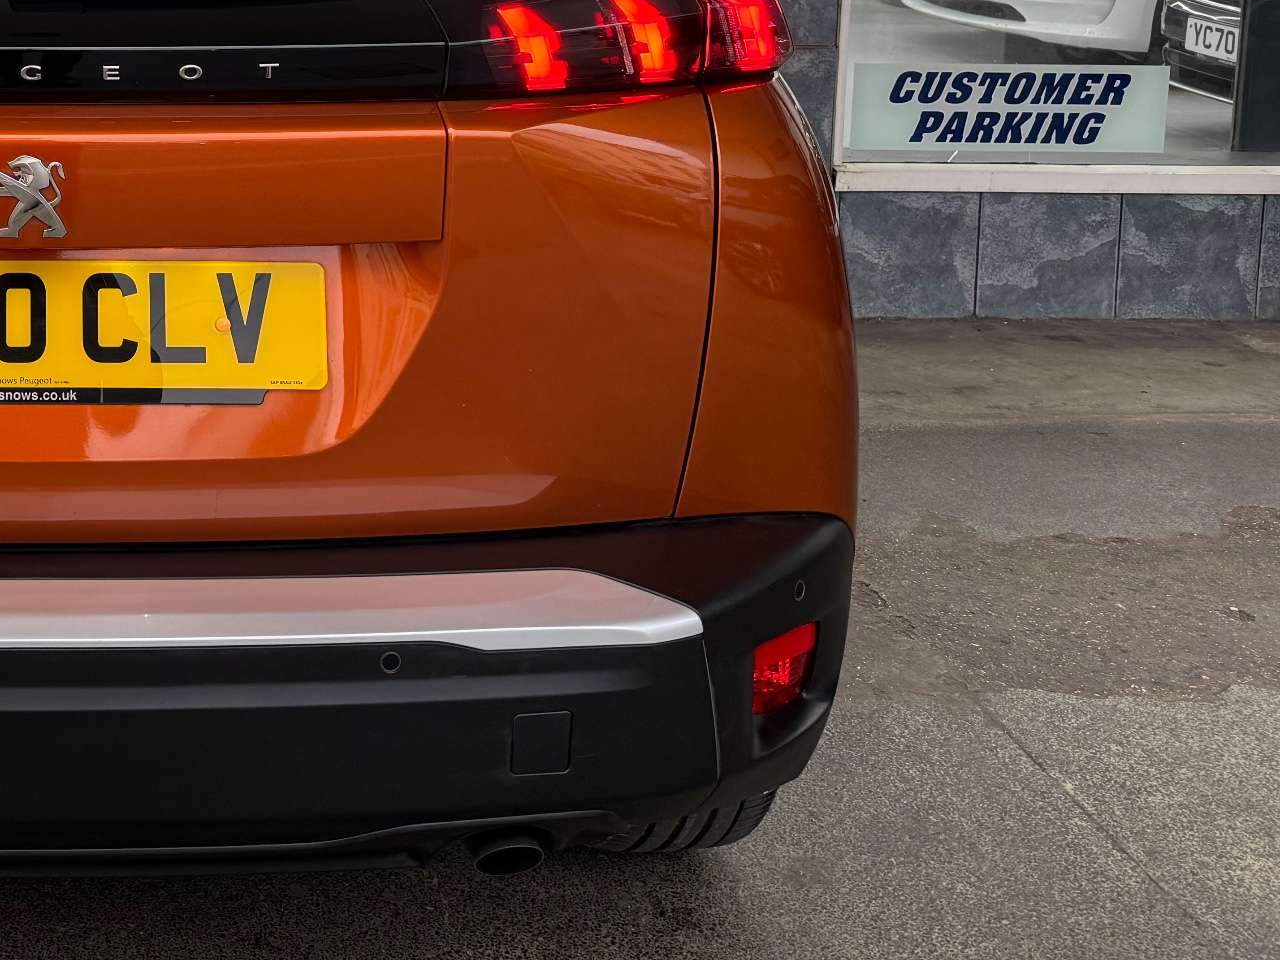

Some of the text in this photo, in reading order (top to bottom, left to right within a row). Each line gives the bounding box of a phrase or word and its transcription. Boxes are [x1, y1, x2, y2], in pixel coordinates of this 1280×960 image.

[1194, 22, 1236, 55] YC70
[888, 70, 1132, 106] CUSTOMER
[908, 110, 1107, 146] PARKING
[81, 272, 273, 364] CLV
[20, 376, 53, 387] Peugeot
